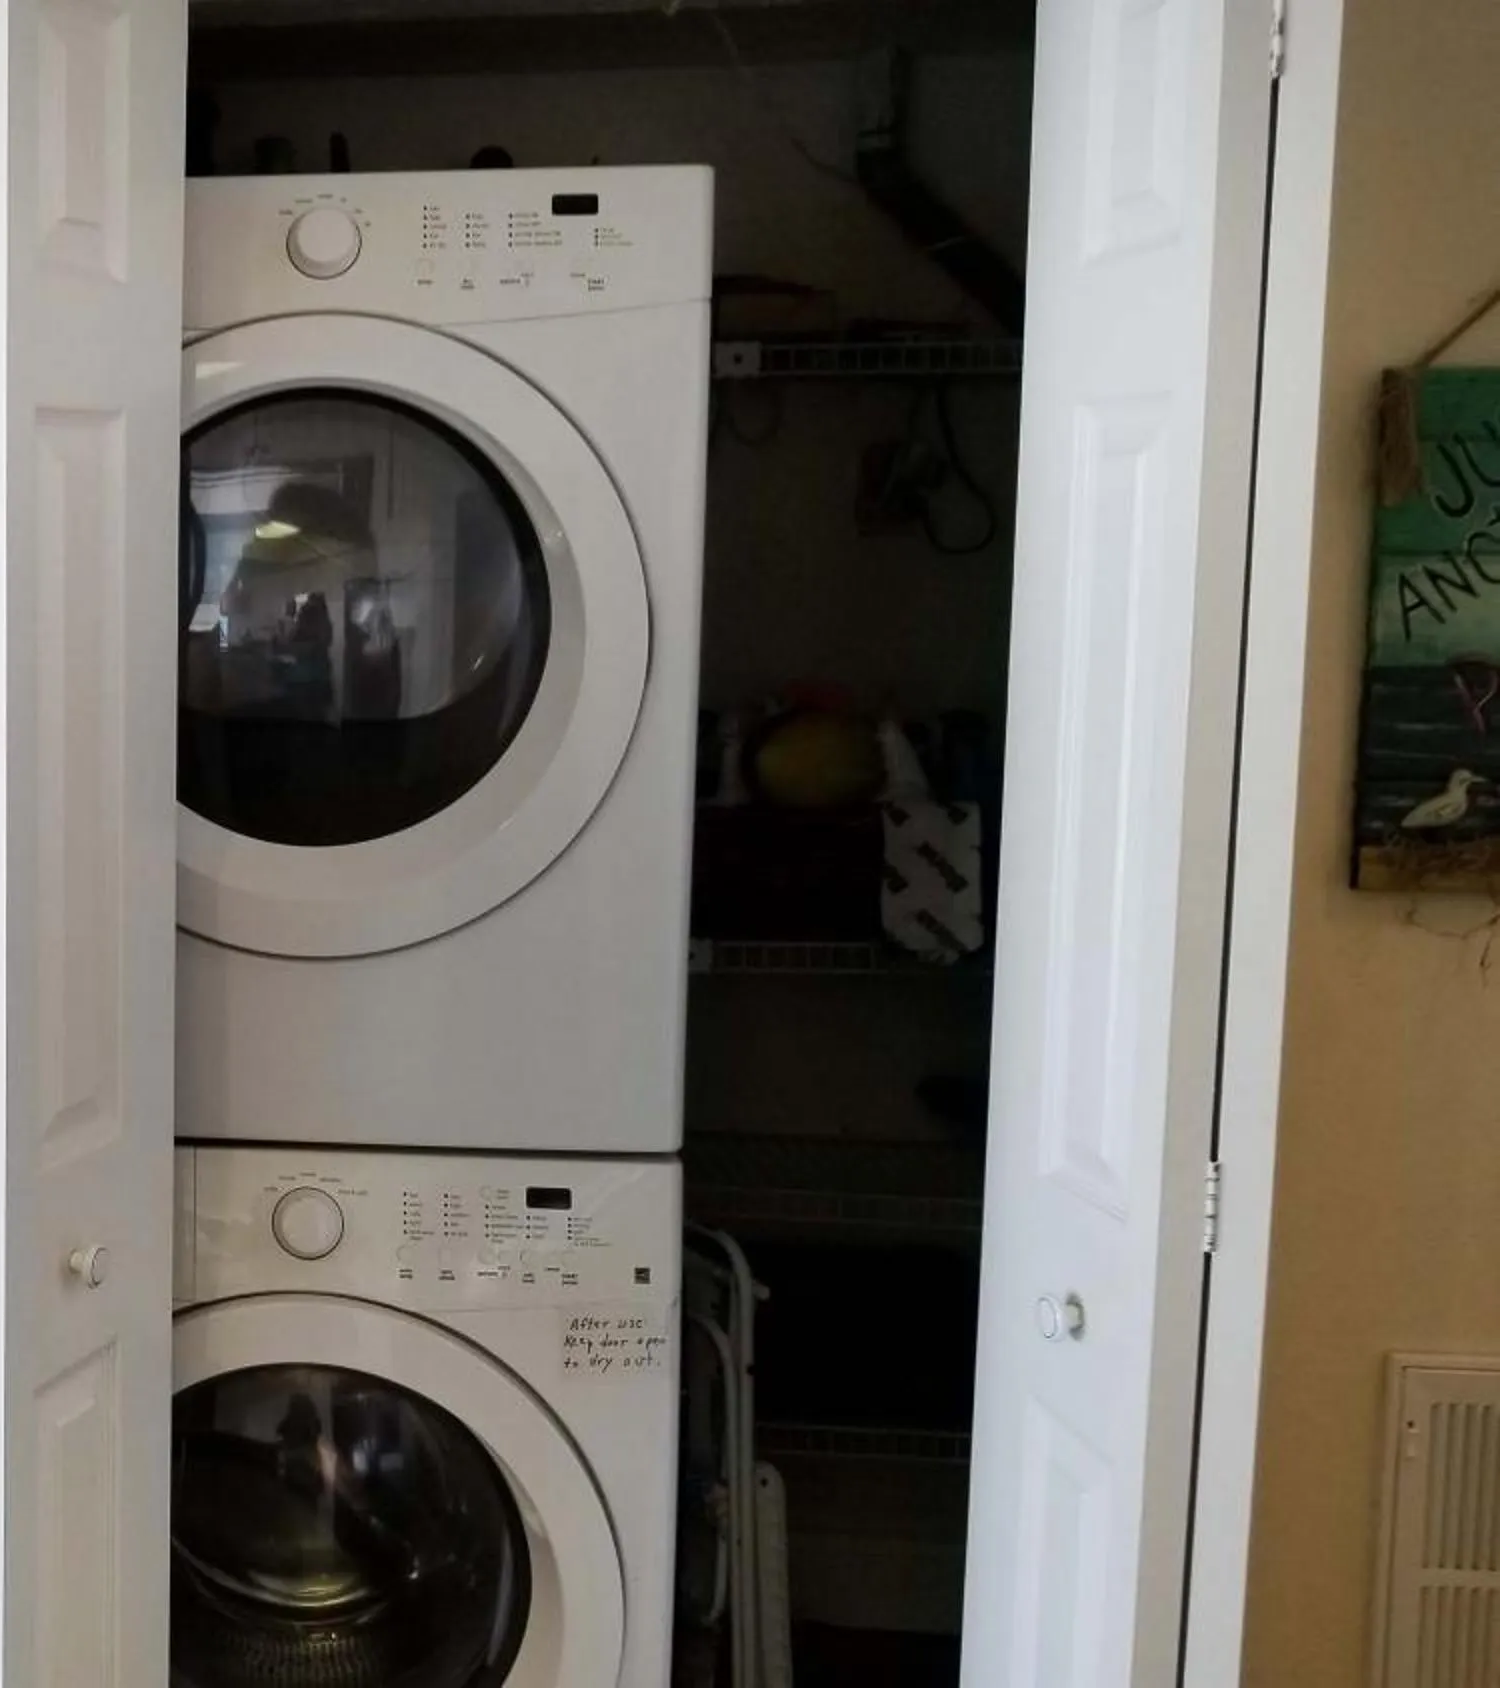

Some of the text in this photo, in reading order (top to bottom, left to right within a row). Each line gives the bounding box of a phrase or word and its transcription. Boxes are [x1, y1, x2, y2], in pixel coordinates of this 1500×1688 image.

[1398, 508, 1500, 642] ANO
[569, 1316, 644, 1331] After use
[599, 1332, 629, 1348] door
[563, 1356, 580, 1369] to
[589, 1353, 613, 1374] dry
